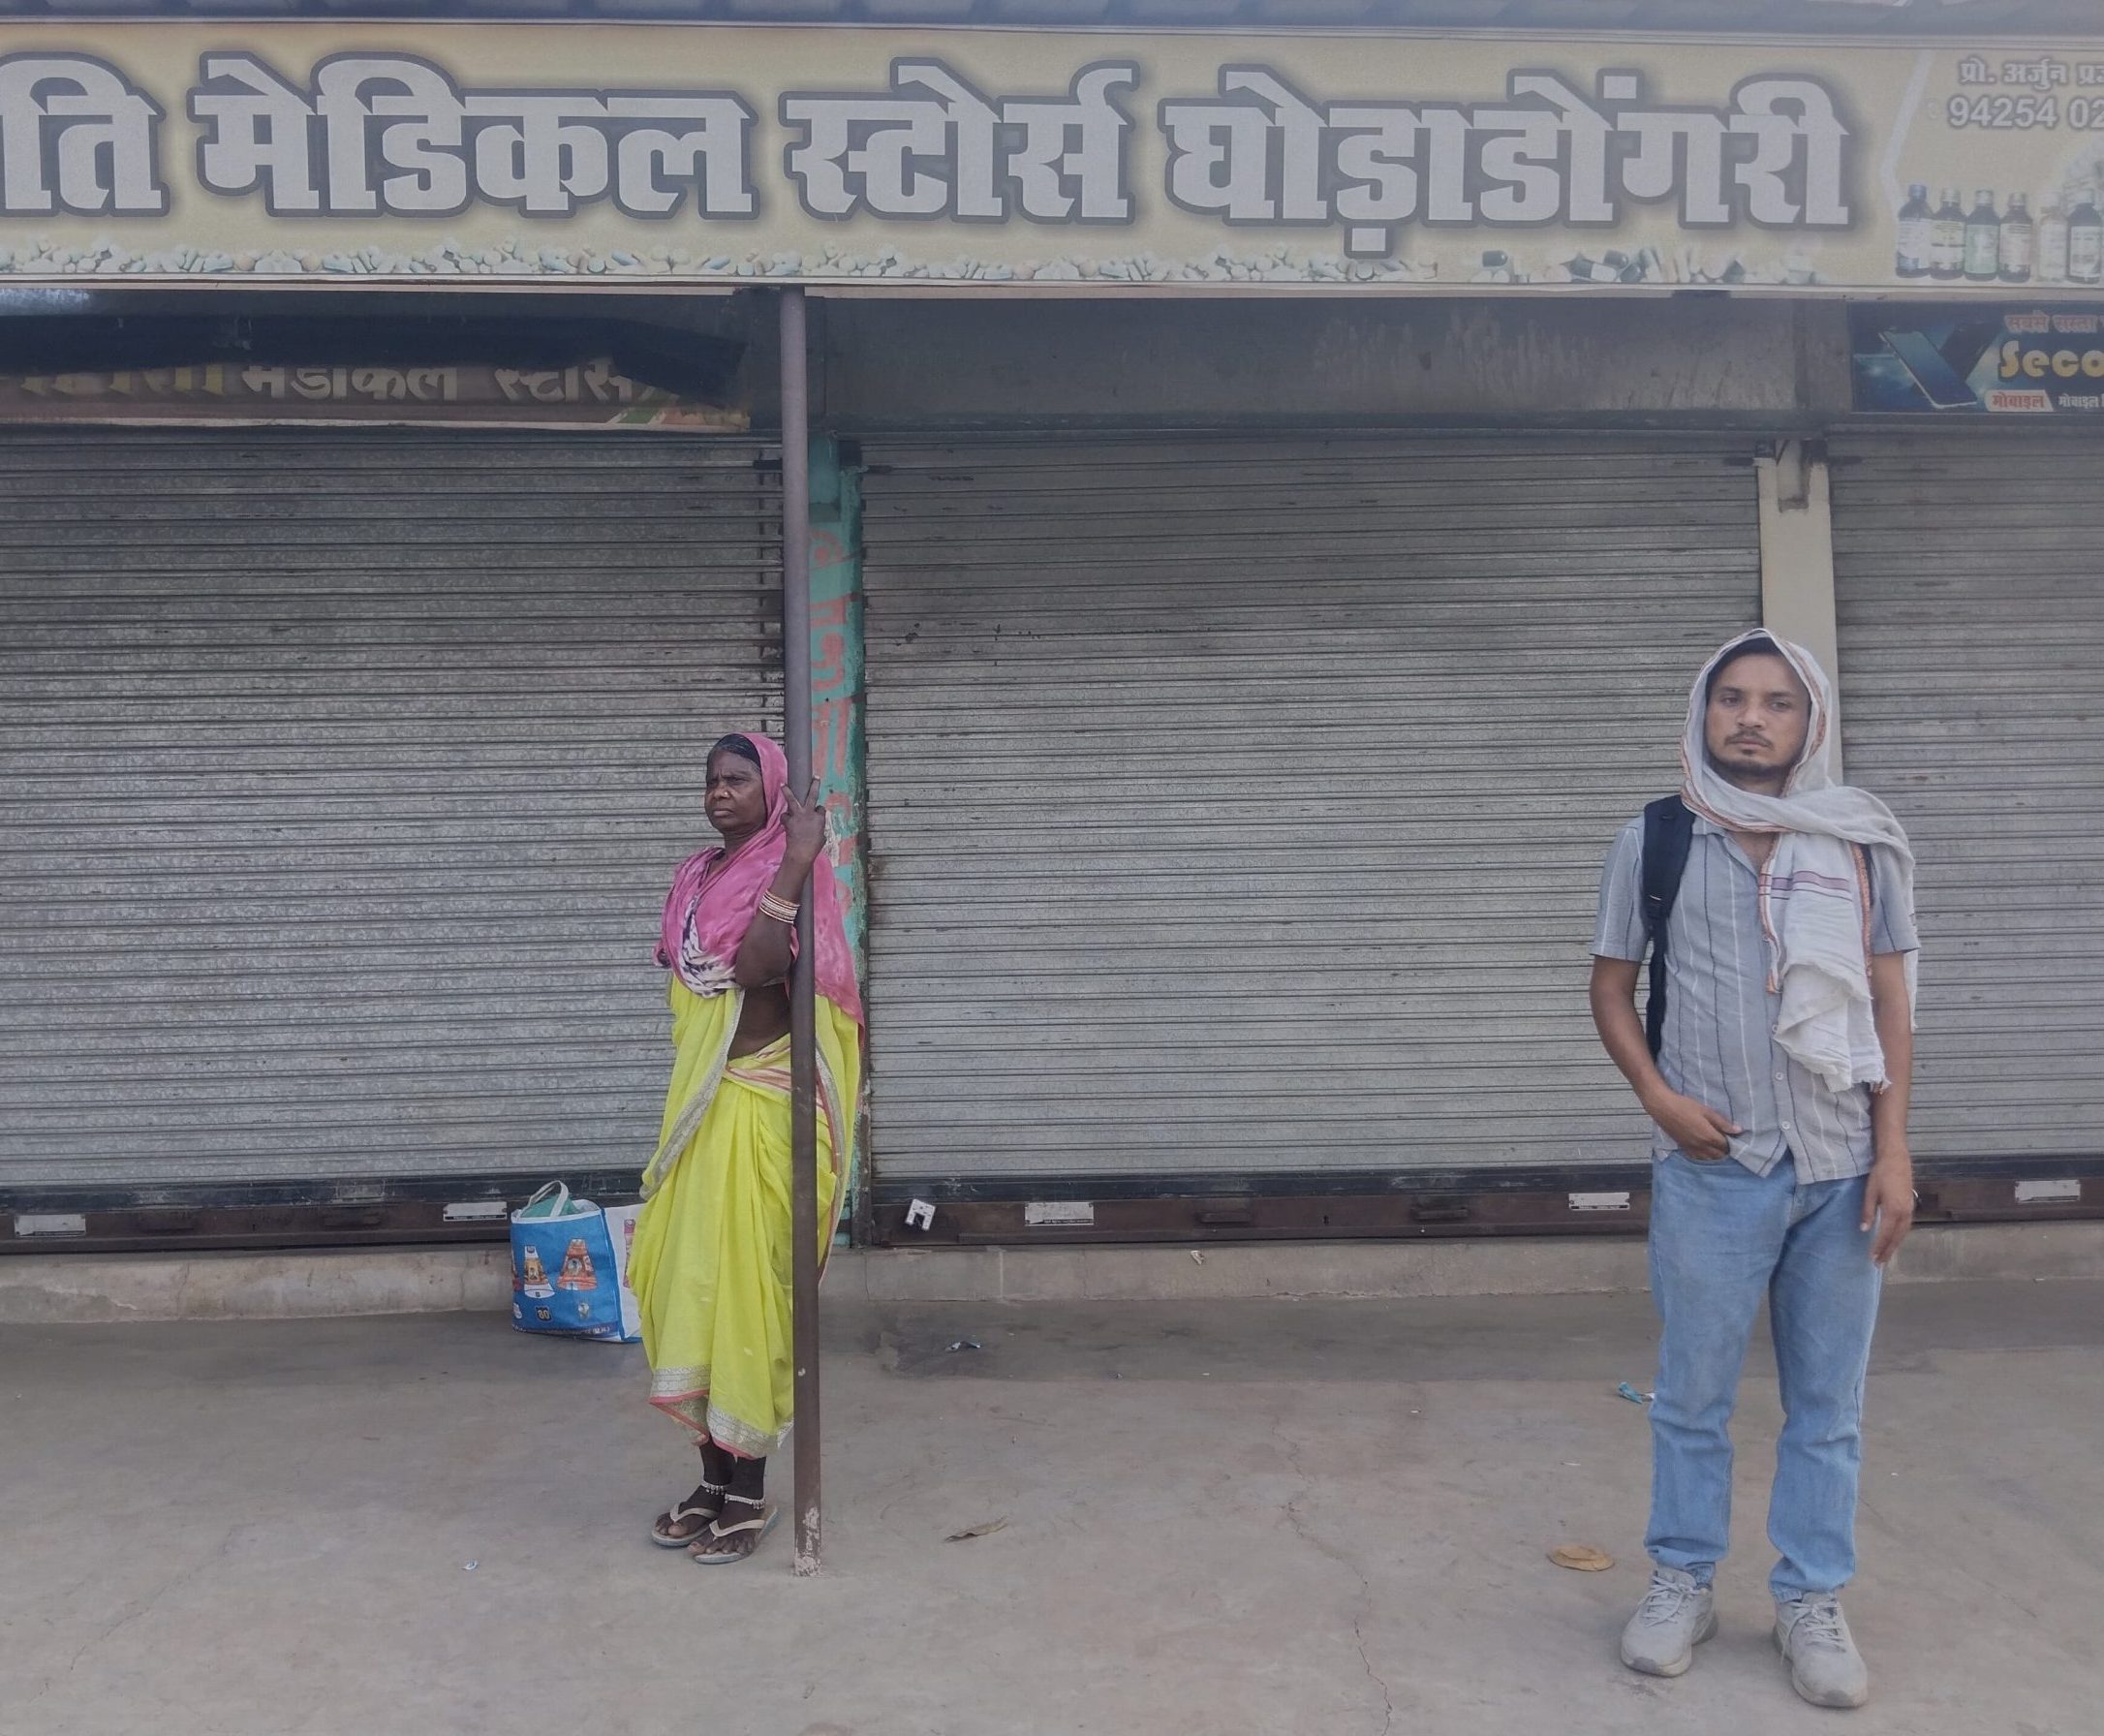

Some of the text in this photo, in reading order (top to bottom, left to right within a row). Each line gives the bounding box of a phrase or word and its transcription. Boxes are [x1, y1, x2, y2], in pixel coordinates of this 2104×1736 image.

[1960, 57, 1996, 83] प्रो.
[2003, 58, 2067, 90] अर्जुन
[1949, 96, 2058, 128] 94254
[194, 57, 753, 212] मेडिकल
[786, 64, 1129, 219] स्टोर्स
[1164, 70, 1850, 253] घोड़ाडोंगरी
[1993, 391, 2045, 408] मोबाइल
